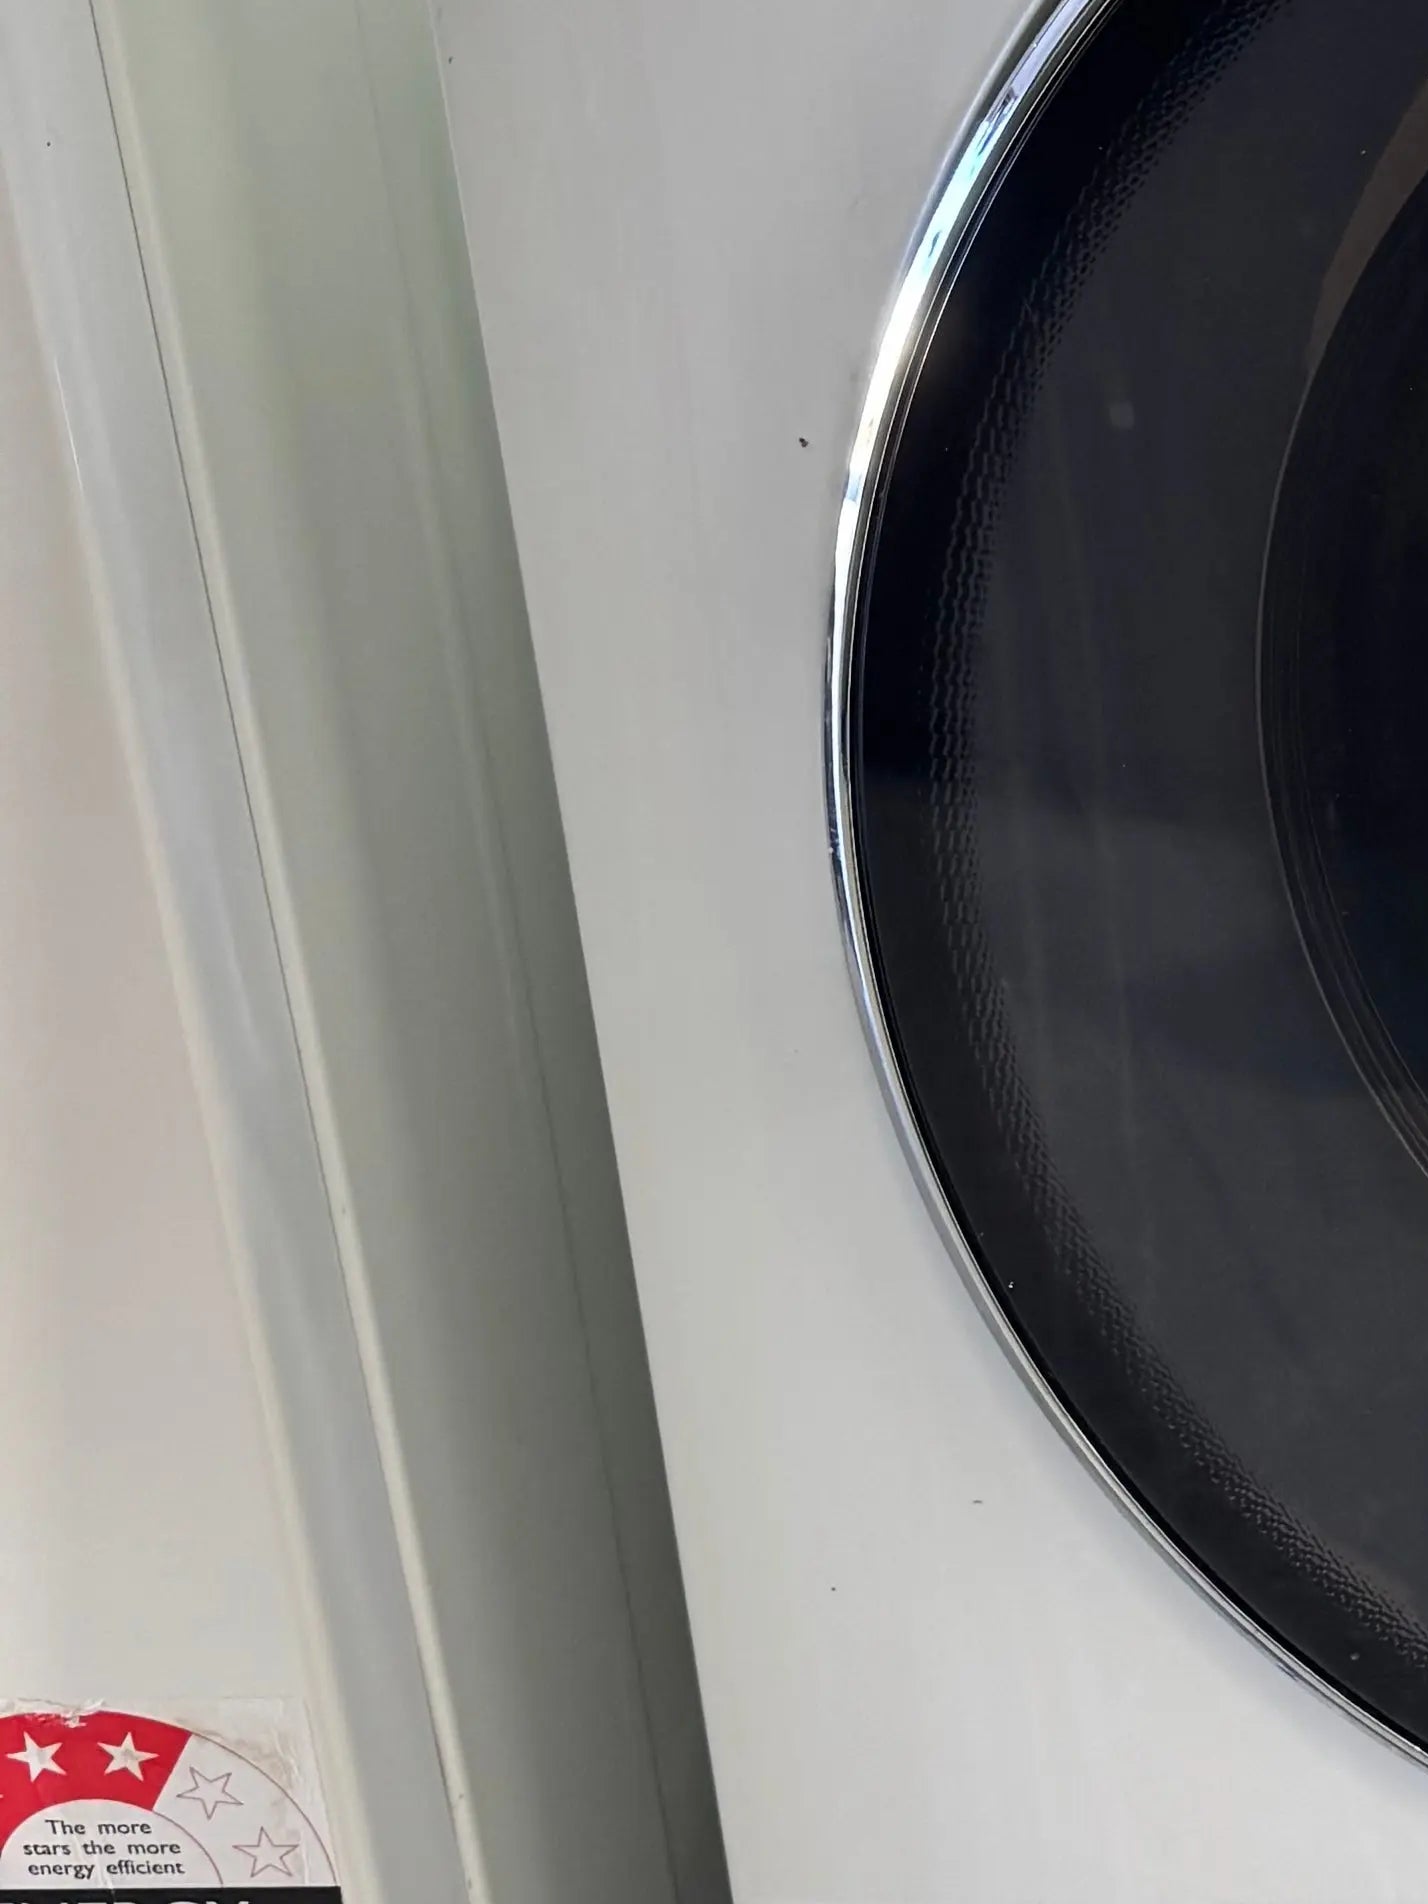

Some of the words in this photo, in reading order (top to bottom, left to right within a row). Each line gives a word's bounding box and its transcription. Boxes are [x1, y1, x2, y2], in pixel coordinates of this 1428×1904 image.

[45, 1819, 86, 1835] The
[98, 1821, 152, 1835] more
[23, 1841, 71, 1856] stars
[82, 1841, 116, 1855] the
[127, 1842, 182, 1855] more
[28, 1861, 95, 1879] energy
[106, 1859, 185, 1875] efficient
